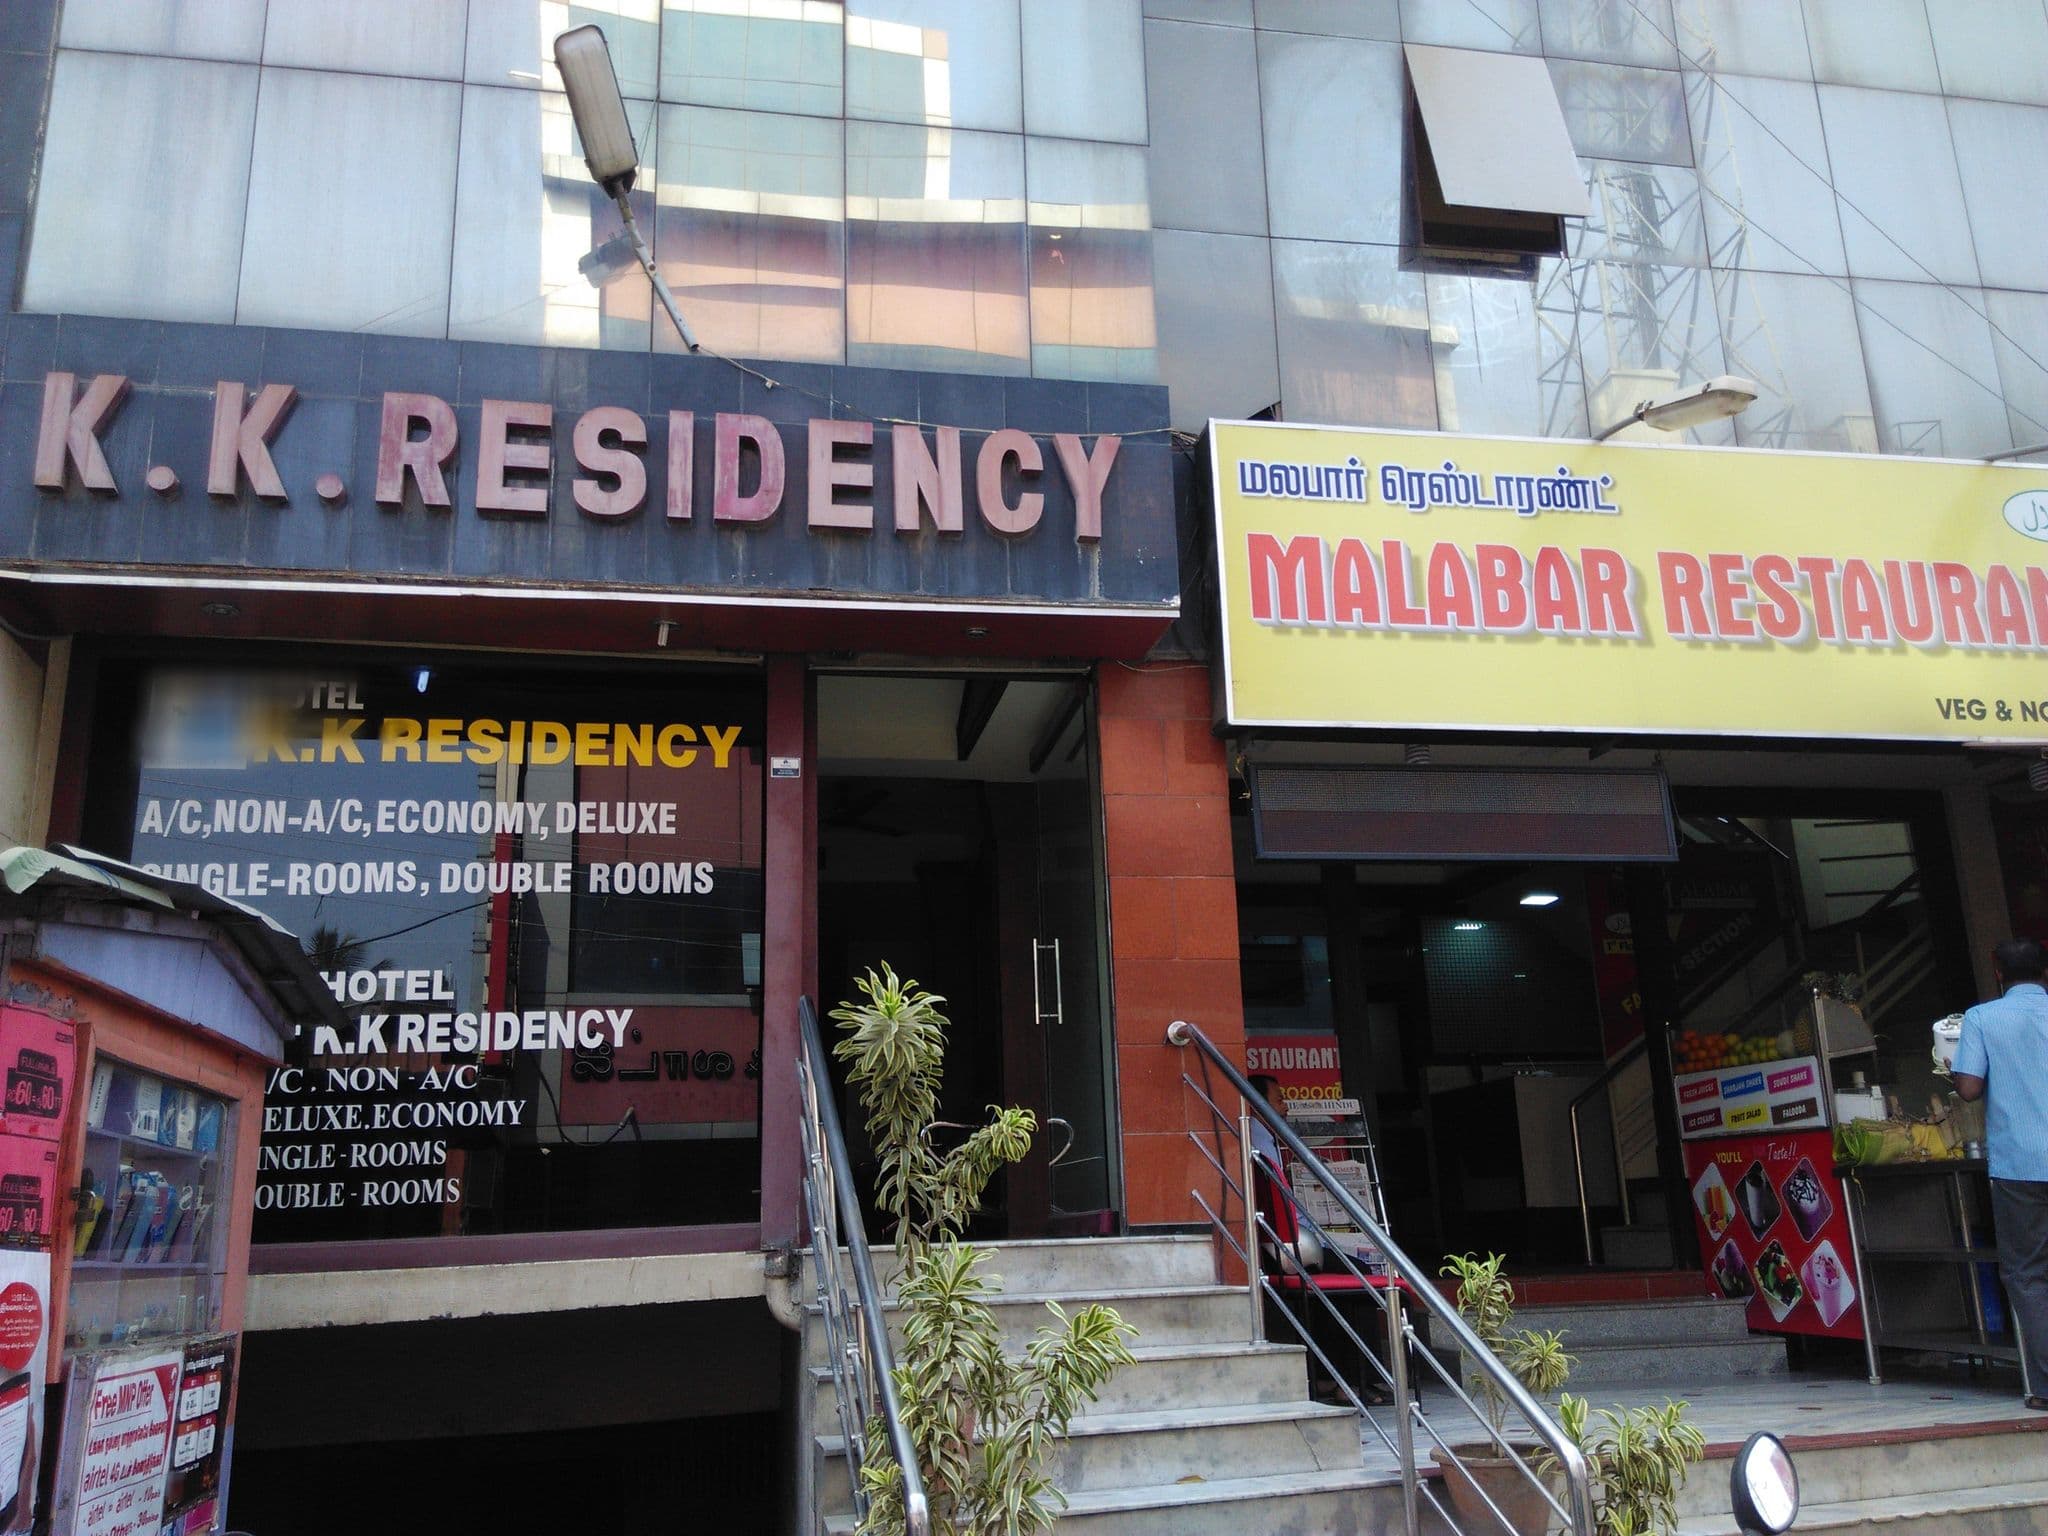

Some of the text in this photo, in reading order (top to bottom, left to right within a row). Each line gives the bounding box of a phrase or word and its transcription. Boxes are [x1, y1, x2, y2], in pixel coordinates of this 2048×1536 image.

[1239, 457, 1617, 516] மலபார் ரெஸ்டாரண்ட்
[1247, 533, 1641, 636] MALABAR
[298, 681, 364, 710] TEL
[1935, 698, 1987, 721] VEG
[1995, 699, 2013, 721] &
[381, 718, 743, 769] RESIDENCY
[440, 862, 573, 895] DOUBLE
[590, 863, 714, 896] ROOMS
[319, 969, 455, 1002] HOTEL
[397, 1009, 634, 1053] RESIDENCY
[1246, 1047, 1341, 1069] STAURANT
[93, 1387, 118, 1420] Free
